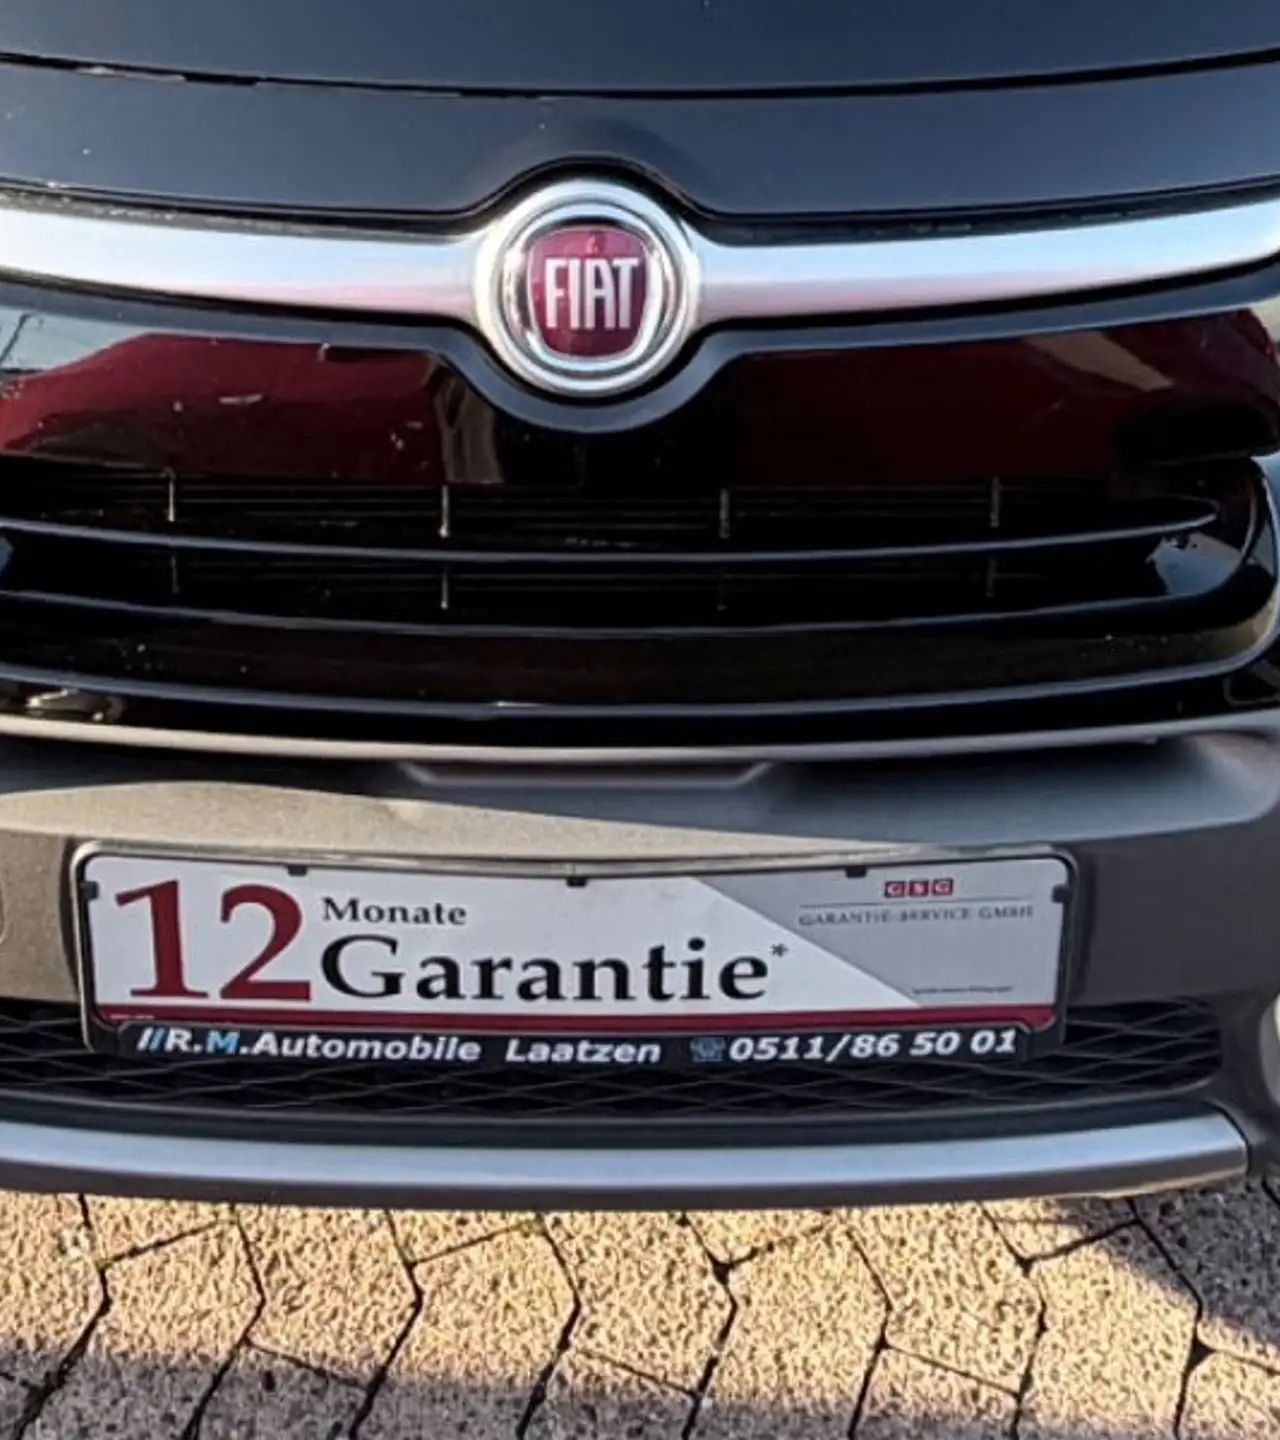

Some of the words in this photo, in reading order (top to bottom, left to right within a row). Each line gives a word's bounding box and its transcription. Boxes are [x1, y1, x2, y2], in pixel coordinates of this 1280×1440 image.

[544, 257, 640, 330] FIAT
[322, 896, 467, 926] Monate
[115, 879, 312, 1001] 12
[504, 1037, 662, 1063] Laatzen
[728, 1033, 900, 1063] 0511/86
[909, 1030, 960, 1057] 50
[970, 1028, 1017, 1054] 01
